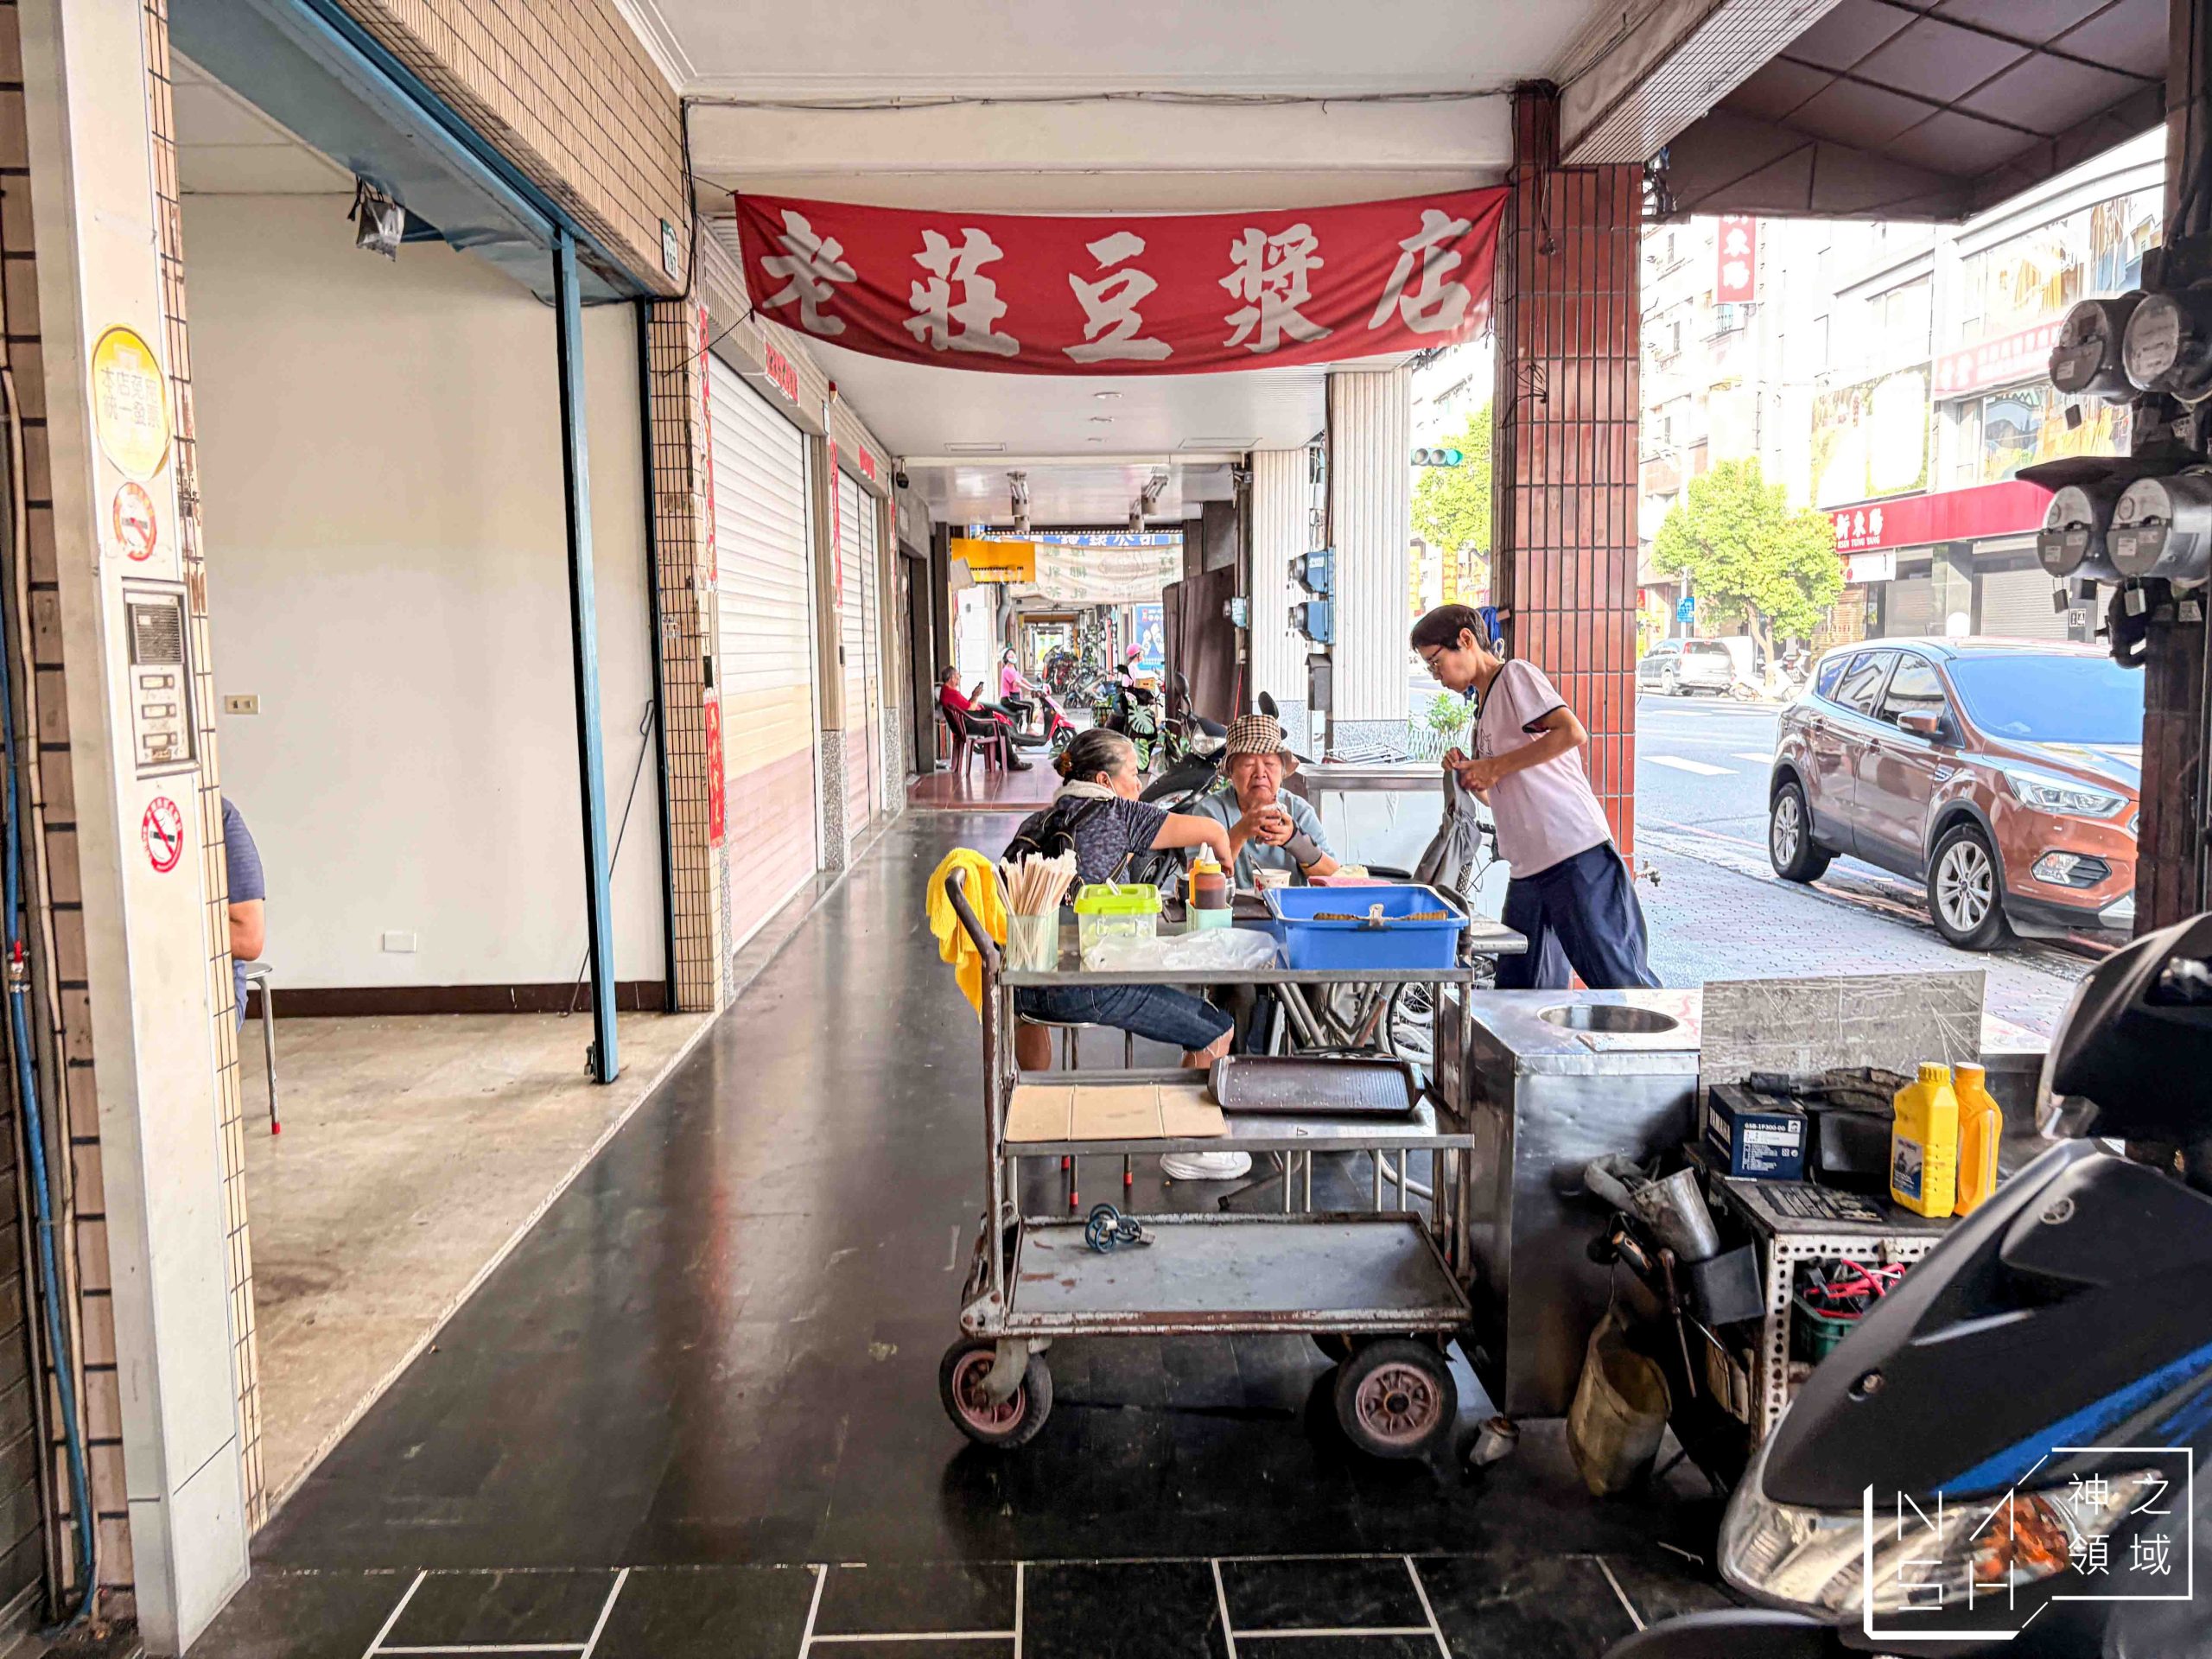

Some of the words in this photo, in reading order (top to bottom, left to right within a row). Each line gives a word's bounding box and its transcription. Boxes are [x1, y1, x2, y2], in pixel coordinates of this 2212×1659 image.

[761, 209, 1474, 364] 老莊豆漿店
